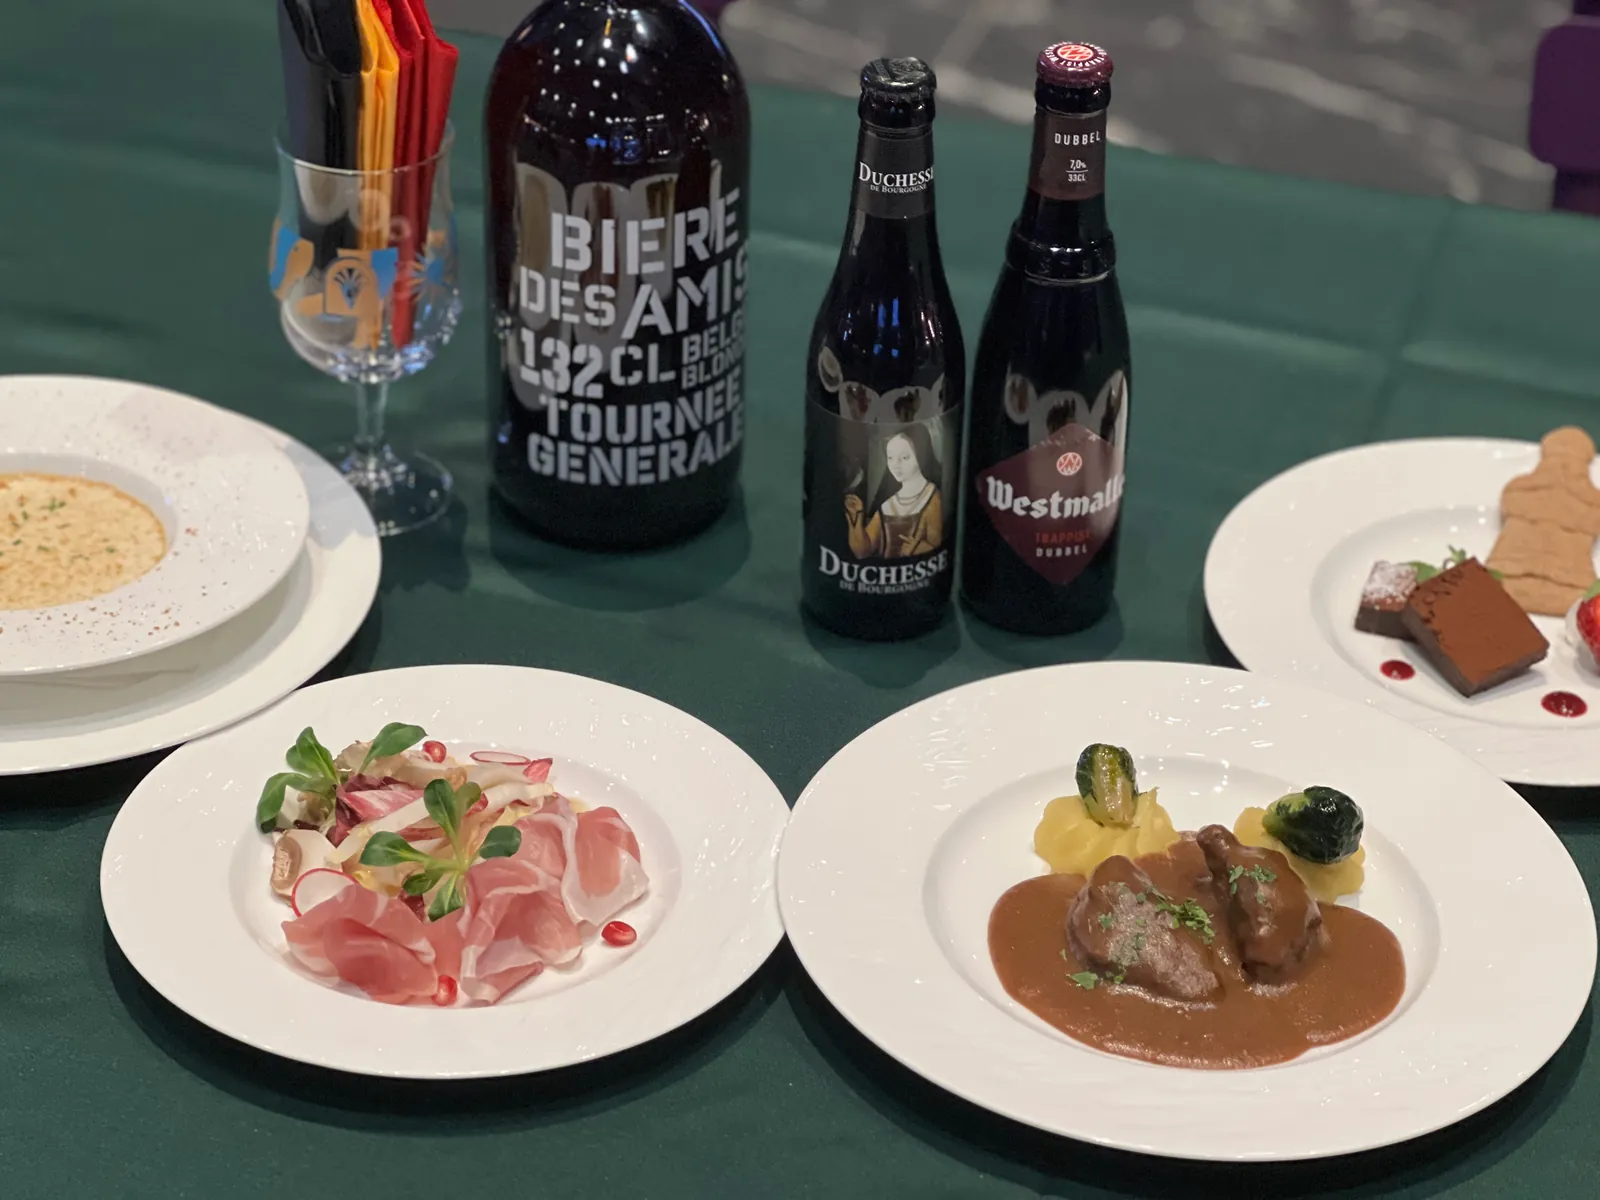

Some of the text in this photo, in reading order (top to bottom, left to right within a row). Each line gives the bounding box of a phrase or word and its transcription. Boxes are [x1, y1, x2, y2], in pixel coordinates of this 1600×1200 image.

[1054, 131, 1100, 146] DUBBEL
[1068, 173, 1086, 182] 33CL
[1070, 159, 1087, 171] 7,0%
[870, 184, 880, 192] DE
[552, 187, 740, 275] BIERE
[520, 266, 616, 328] DES
[520, 327, 676, 400] 132 CL
[539, 369, 742, 444] TOURNEE
[527, 404, 746, 486] GENERALE
[819, 545, 948, 585] DUCHESSE
[1036, 543, 1088, 558] DUBBEL
